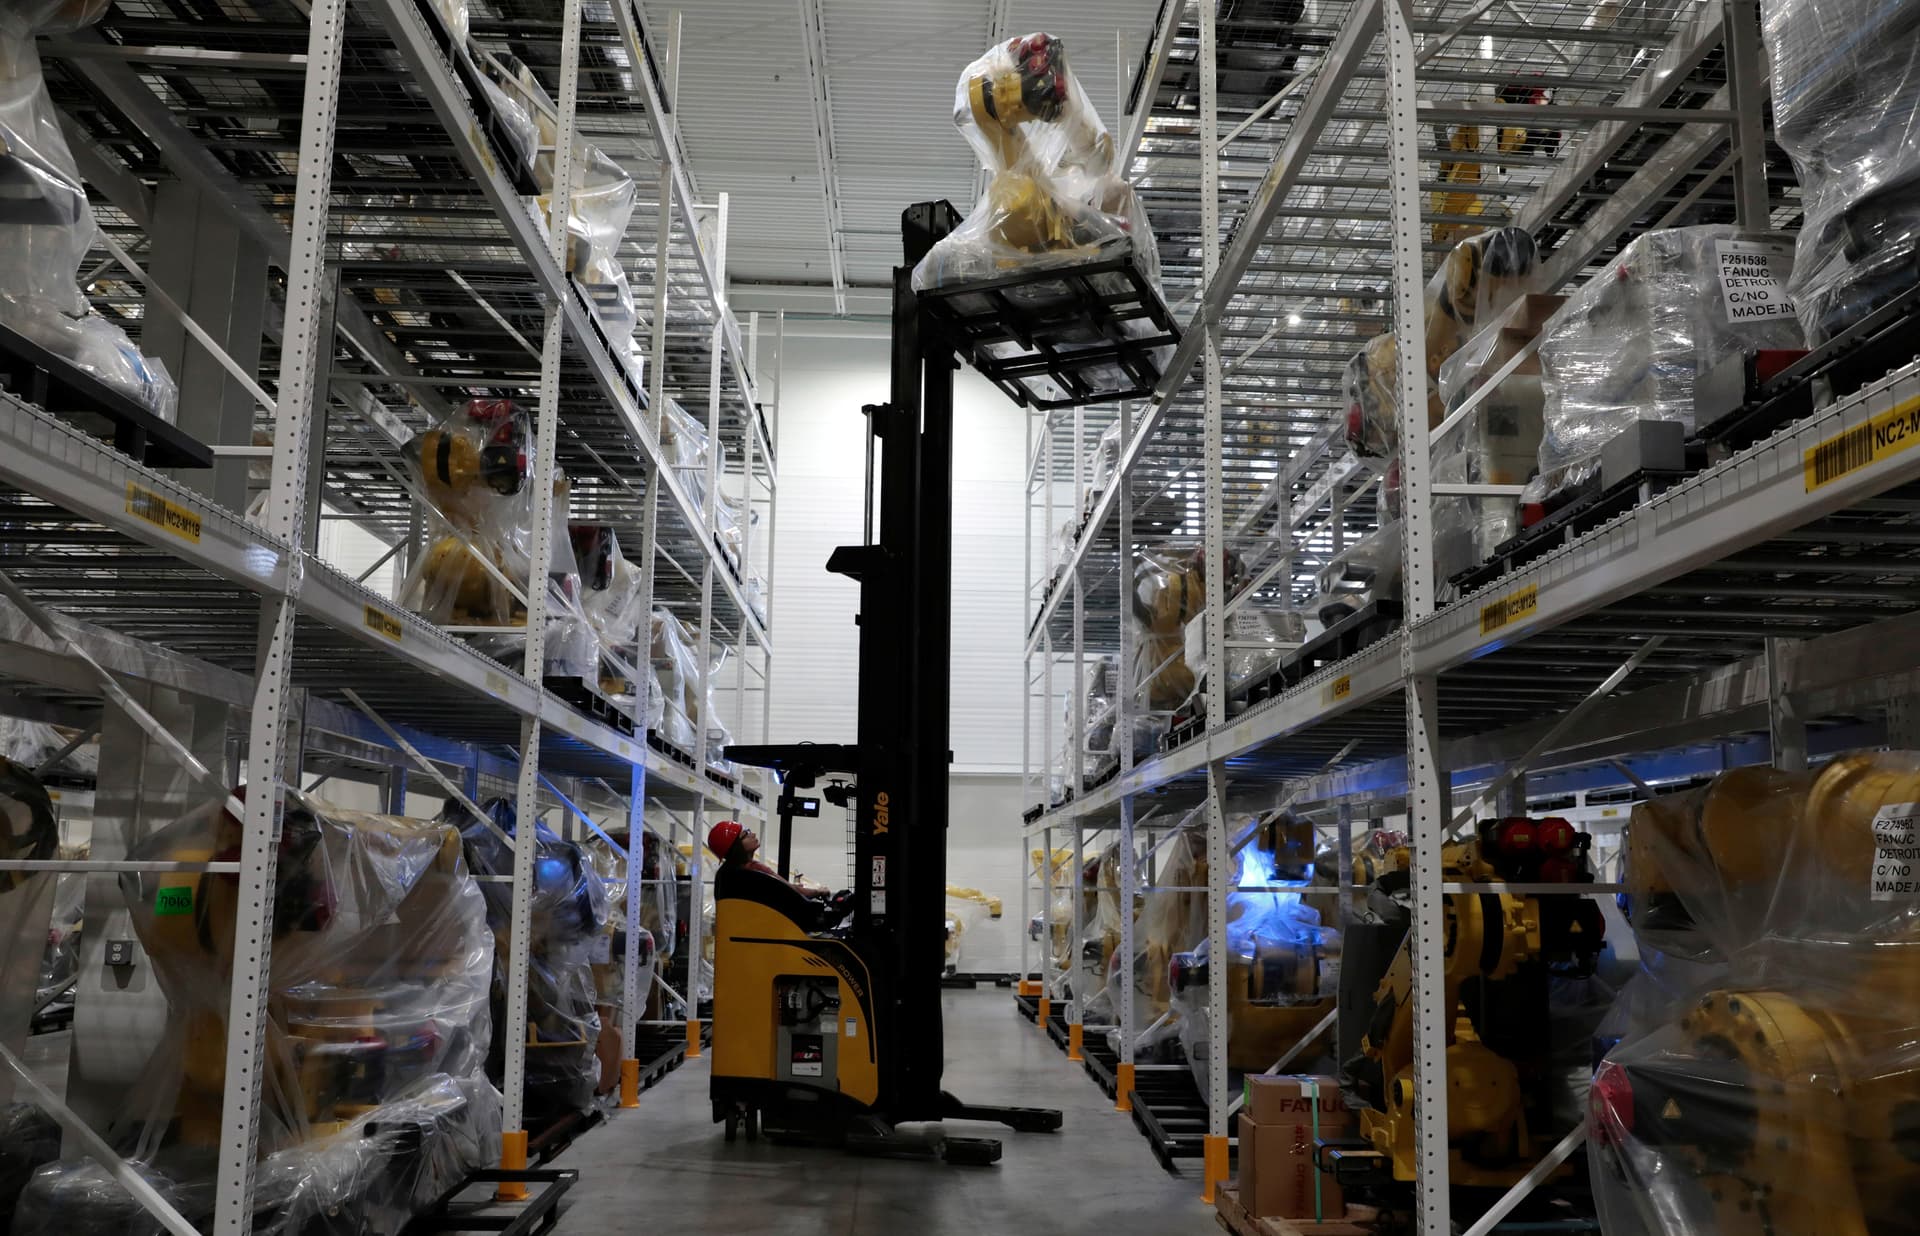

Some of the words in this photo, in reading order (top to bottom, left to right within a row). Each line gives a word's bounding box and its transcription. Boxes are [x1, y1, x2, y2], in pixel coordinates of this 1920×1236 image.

[1721, 254, 1767, 266] F251538
[1723, 267, 1769, 278] FANUC
[1725, 277, 1778, 288] DETROIT
[1729, 290, 1769, 303] C/NO
[1732, 304, 1777, 318] MADE
[1781, 302, 1796, 314] IN
[873, 791, 890, 836] Yale
[1876, 834, 1915, 845] FANUC
[1877, 865, 1911, 877] C/NO
[1875, 881, 1912, 893] MADE
[837, 964, 864, 998] POWER
